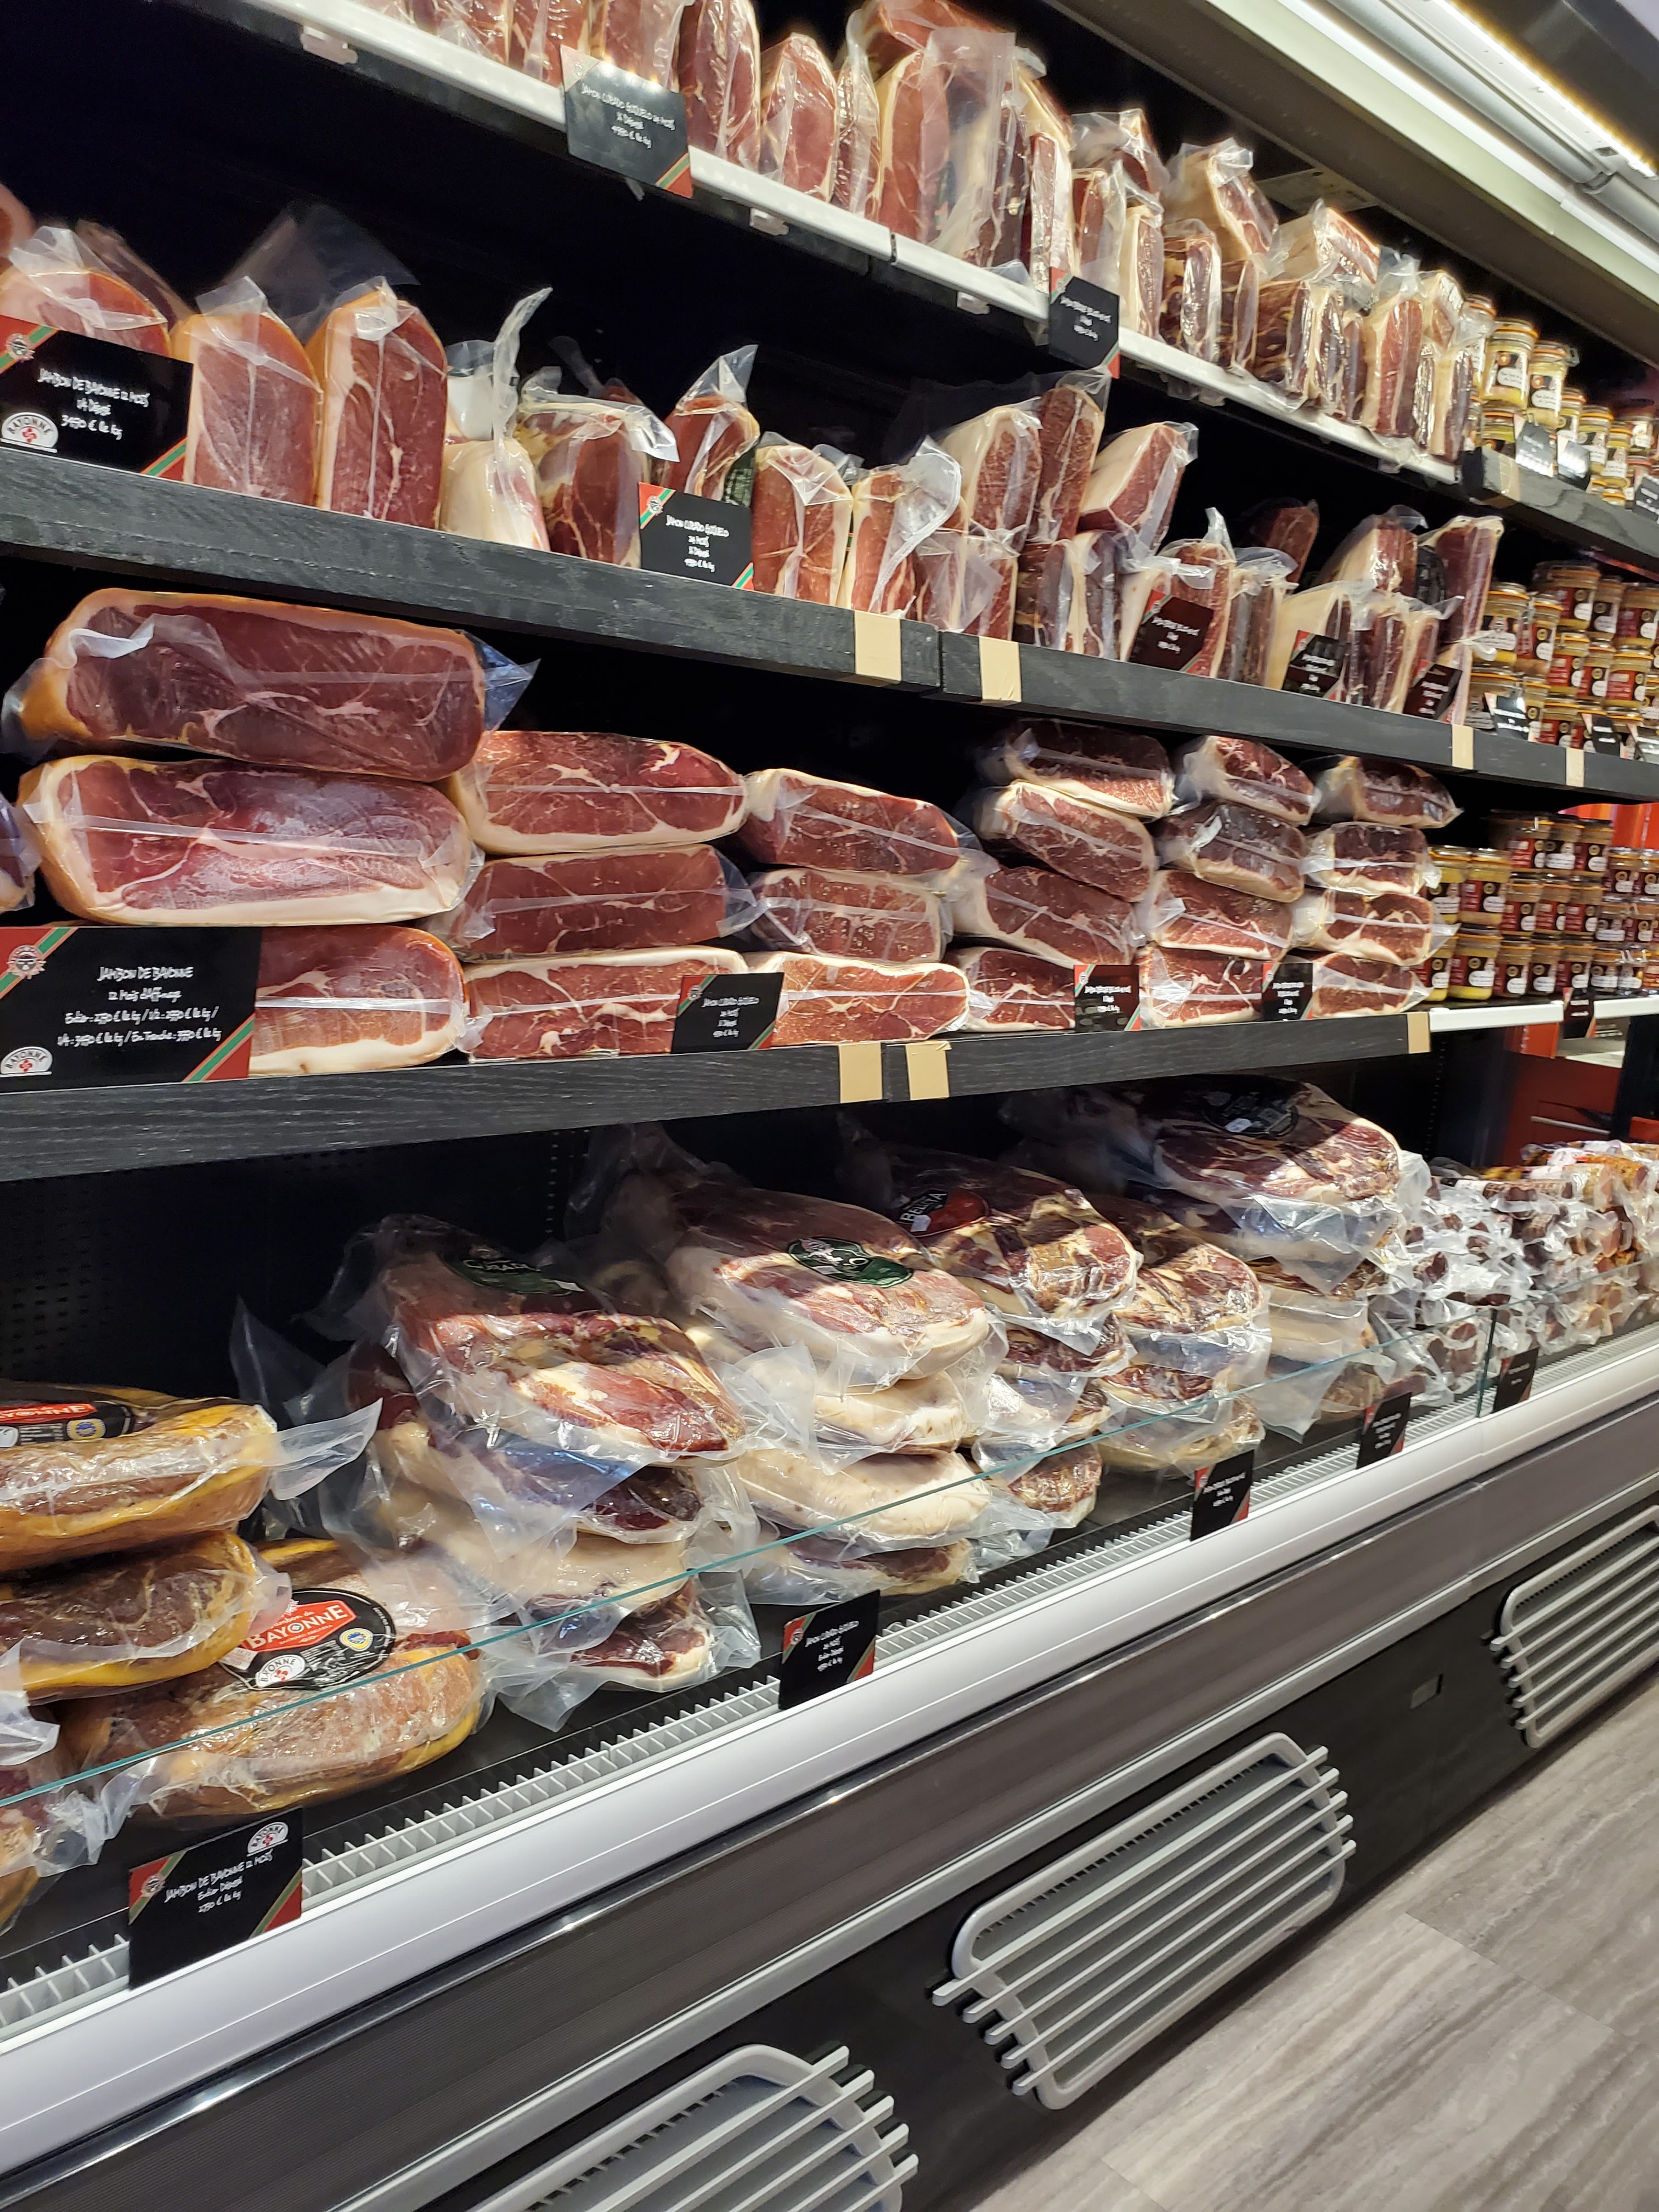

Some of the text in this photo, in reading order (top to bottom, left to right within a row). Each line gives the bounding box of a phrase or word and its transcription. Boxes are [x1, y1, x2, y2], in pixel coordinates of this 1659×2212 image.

[97, 967, 194, 981] JAMBON DE BAYONNE
[247, 1604, 348, 1649] BAYONNE
[164, 1881, 198, 1903] JAMBON
[198, 1875, 210, 1888] DE
[210, 1861, 245, 1885] BAYONNE
